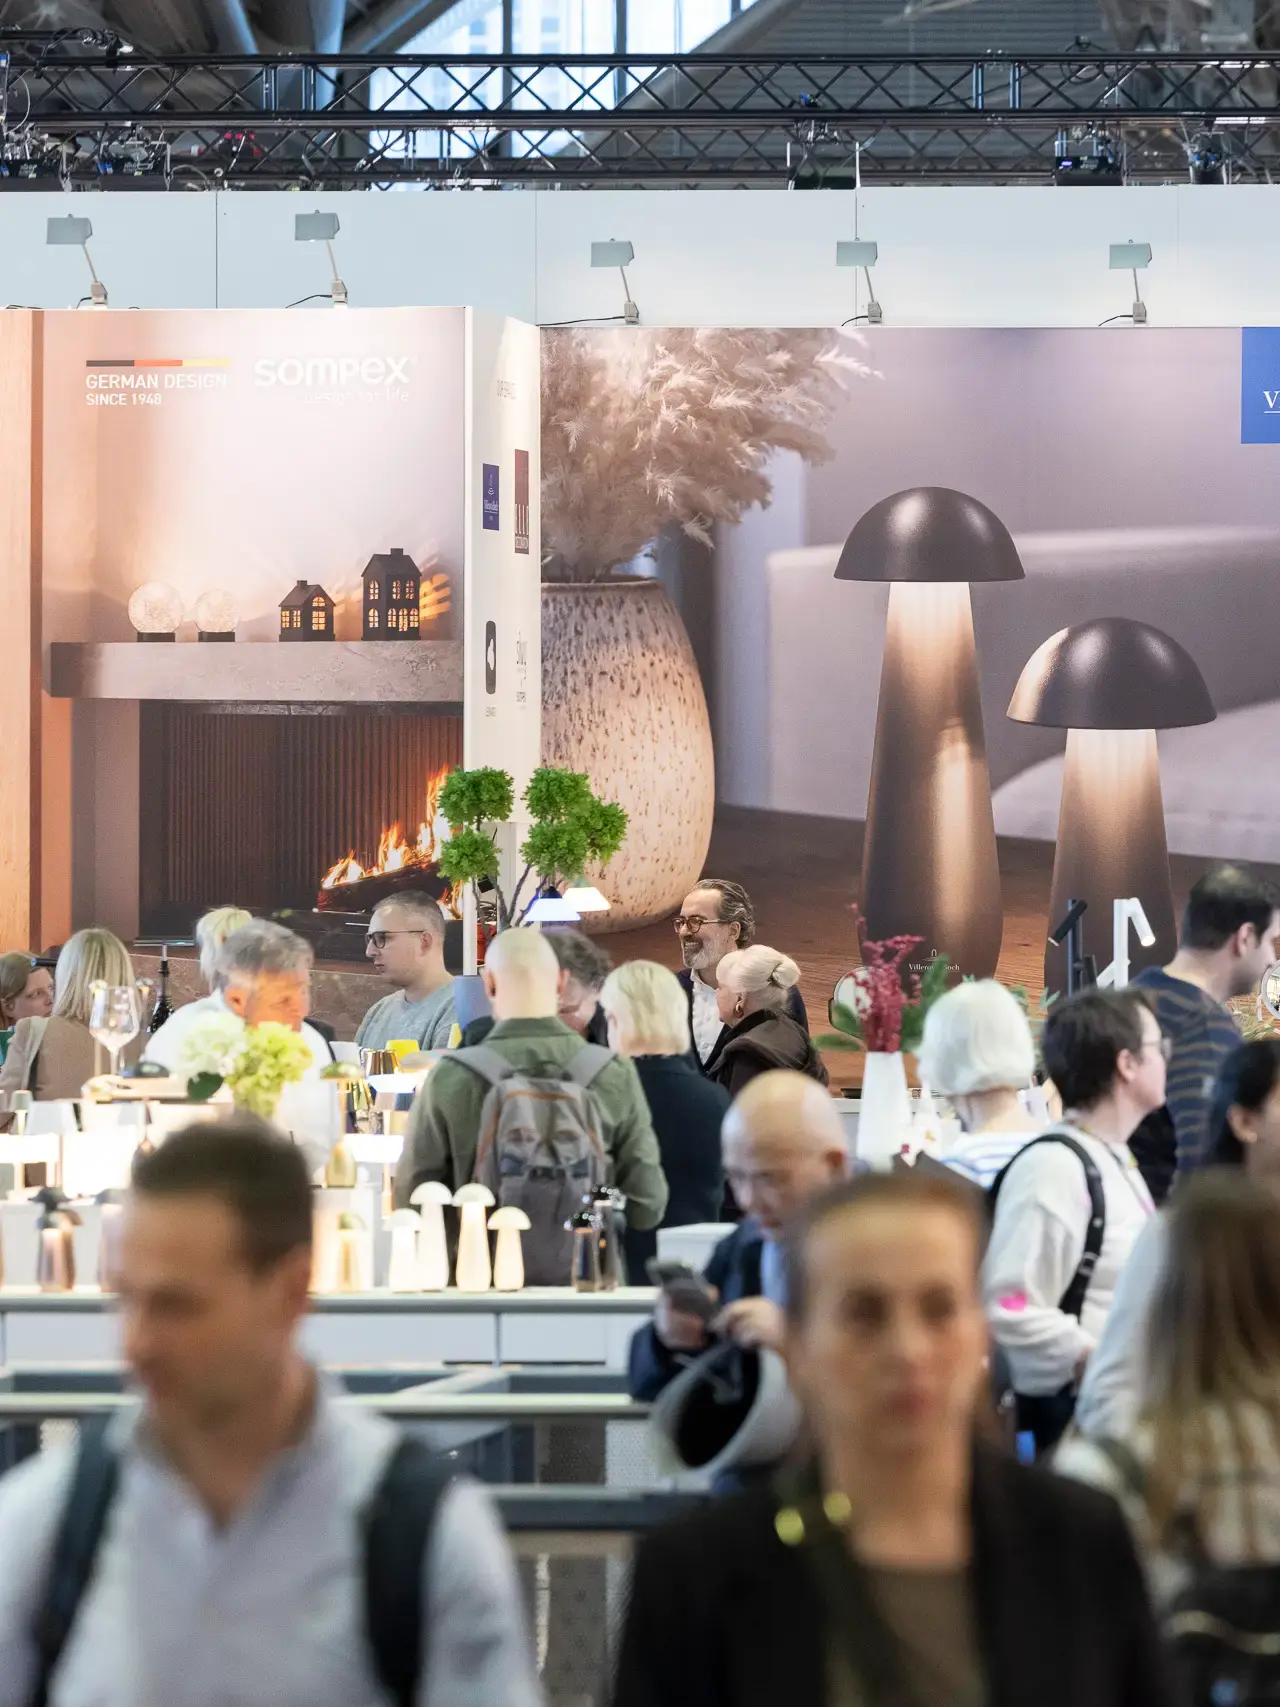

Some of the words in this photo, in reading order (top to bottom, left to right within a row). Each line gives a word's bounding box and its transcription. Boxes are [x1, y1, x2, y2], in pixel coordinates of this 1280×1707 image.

[254, 356, 410, 387] sompex
[86, 374, 159, 389] GERMAN
[164, 373, 227, 389] DESIGN
[86, 393, 127, 406] SINCE
[131, 393, 162, 406] 1948
[909, 963, 934, 971] Villero
